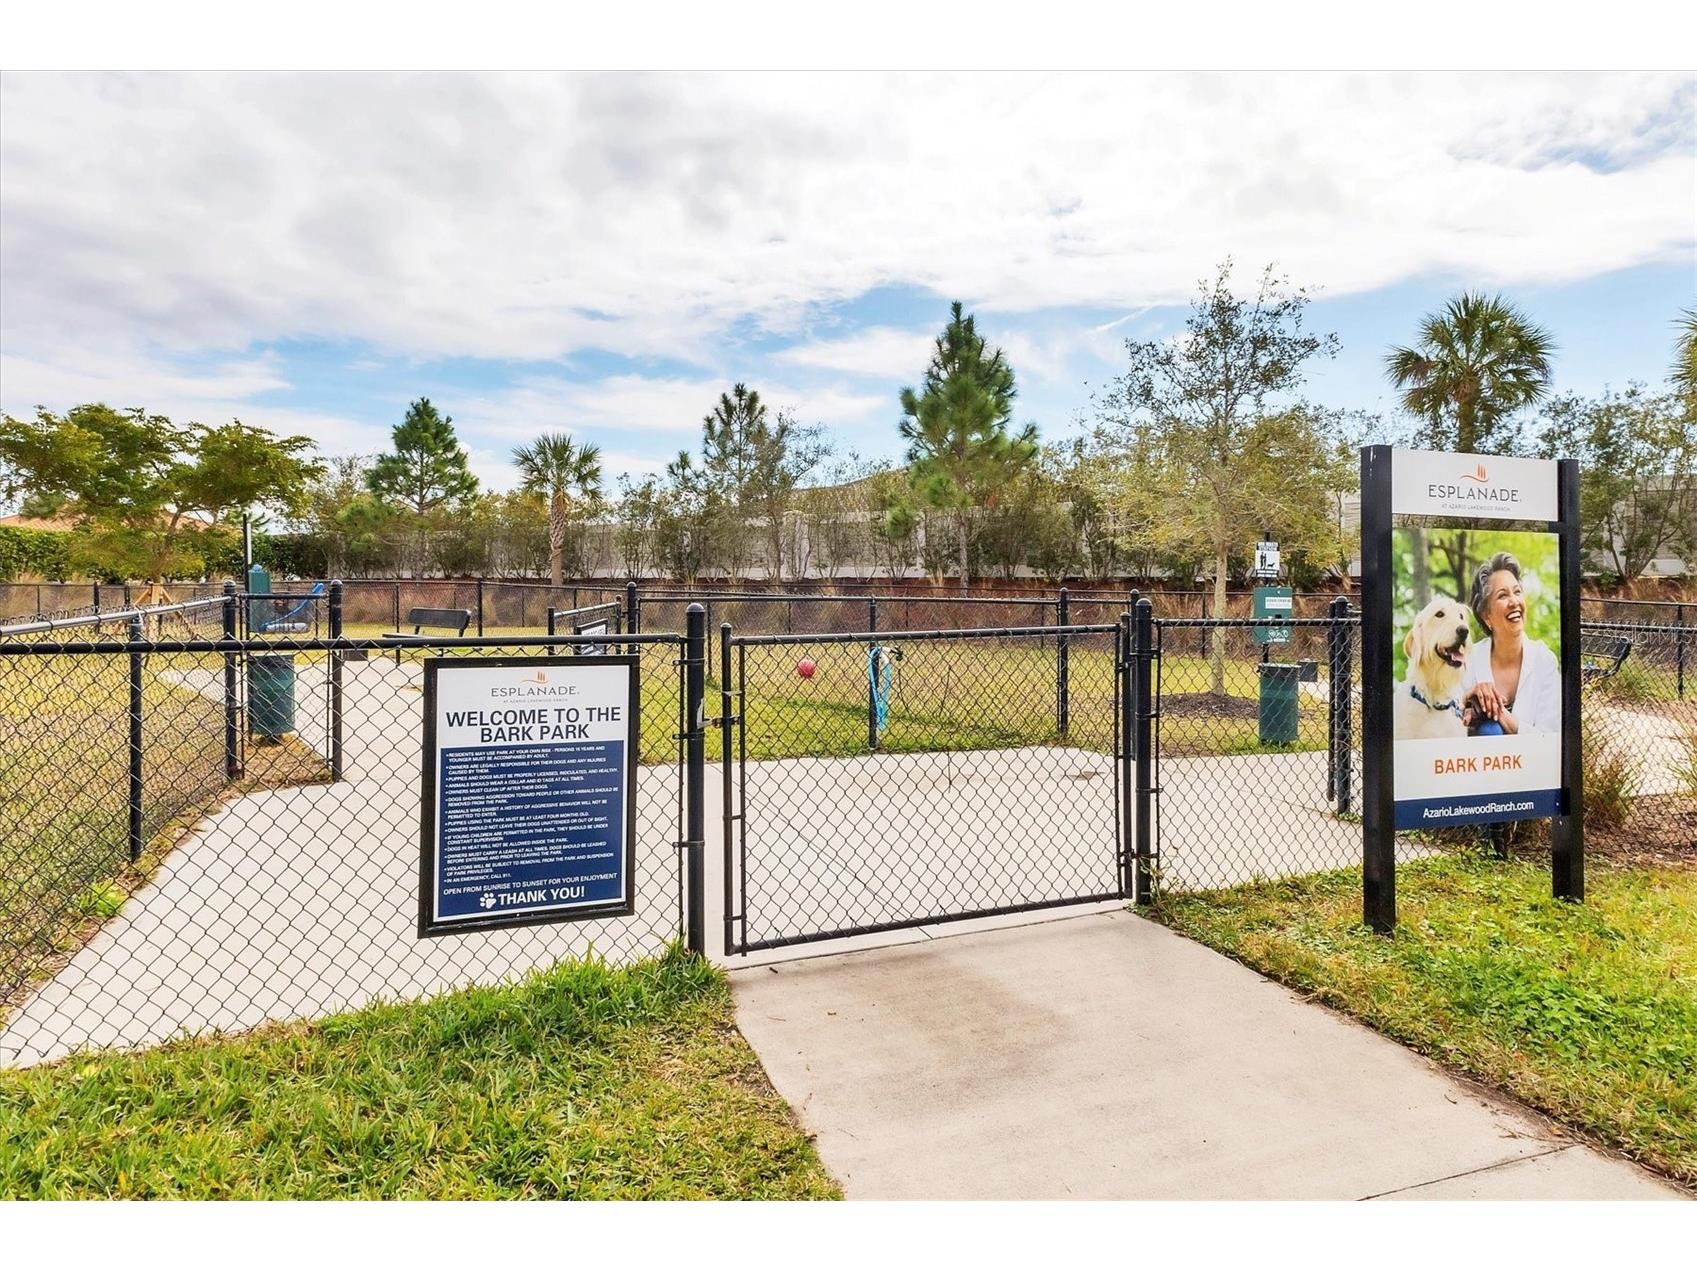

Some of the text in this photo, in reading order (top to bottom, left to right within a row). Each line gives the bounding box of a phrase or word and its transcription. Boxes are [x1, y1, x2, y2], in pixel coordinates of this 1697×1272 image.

[1428, 484, 1519, 502] ESPLANADE
[491, 686, 577, 697] ESPLANADE
[446, 706, 621, 727] WELCOME TO THE
[480, 723, 590, 743] BARK PARK
[1434, 754, 1522, 774] BARK PARK
[1423, 801, 1534, 818] AzarioLakewoodRanch.com
[443, 886, 461, 895] OPEN
[462, 885, 481, 893] FROM
[482, 882, 511, 891] SUNRISE
[522, 878, 546, 887] SUNSET
[562, 875, 579, 883] YOUR
[580, 872, 617, 882] ENJOYMENT
[497, 885, 584, 906] THANK YOU!
